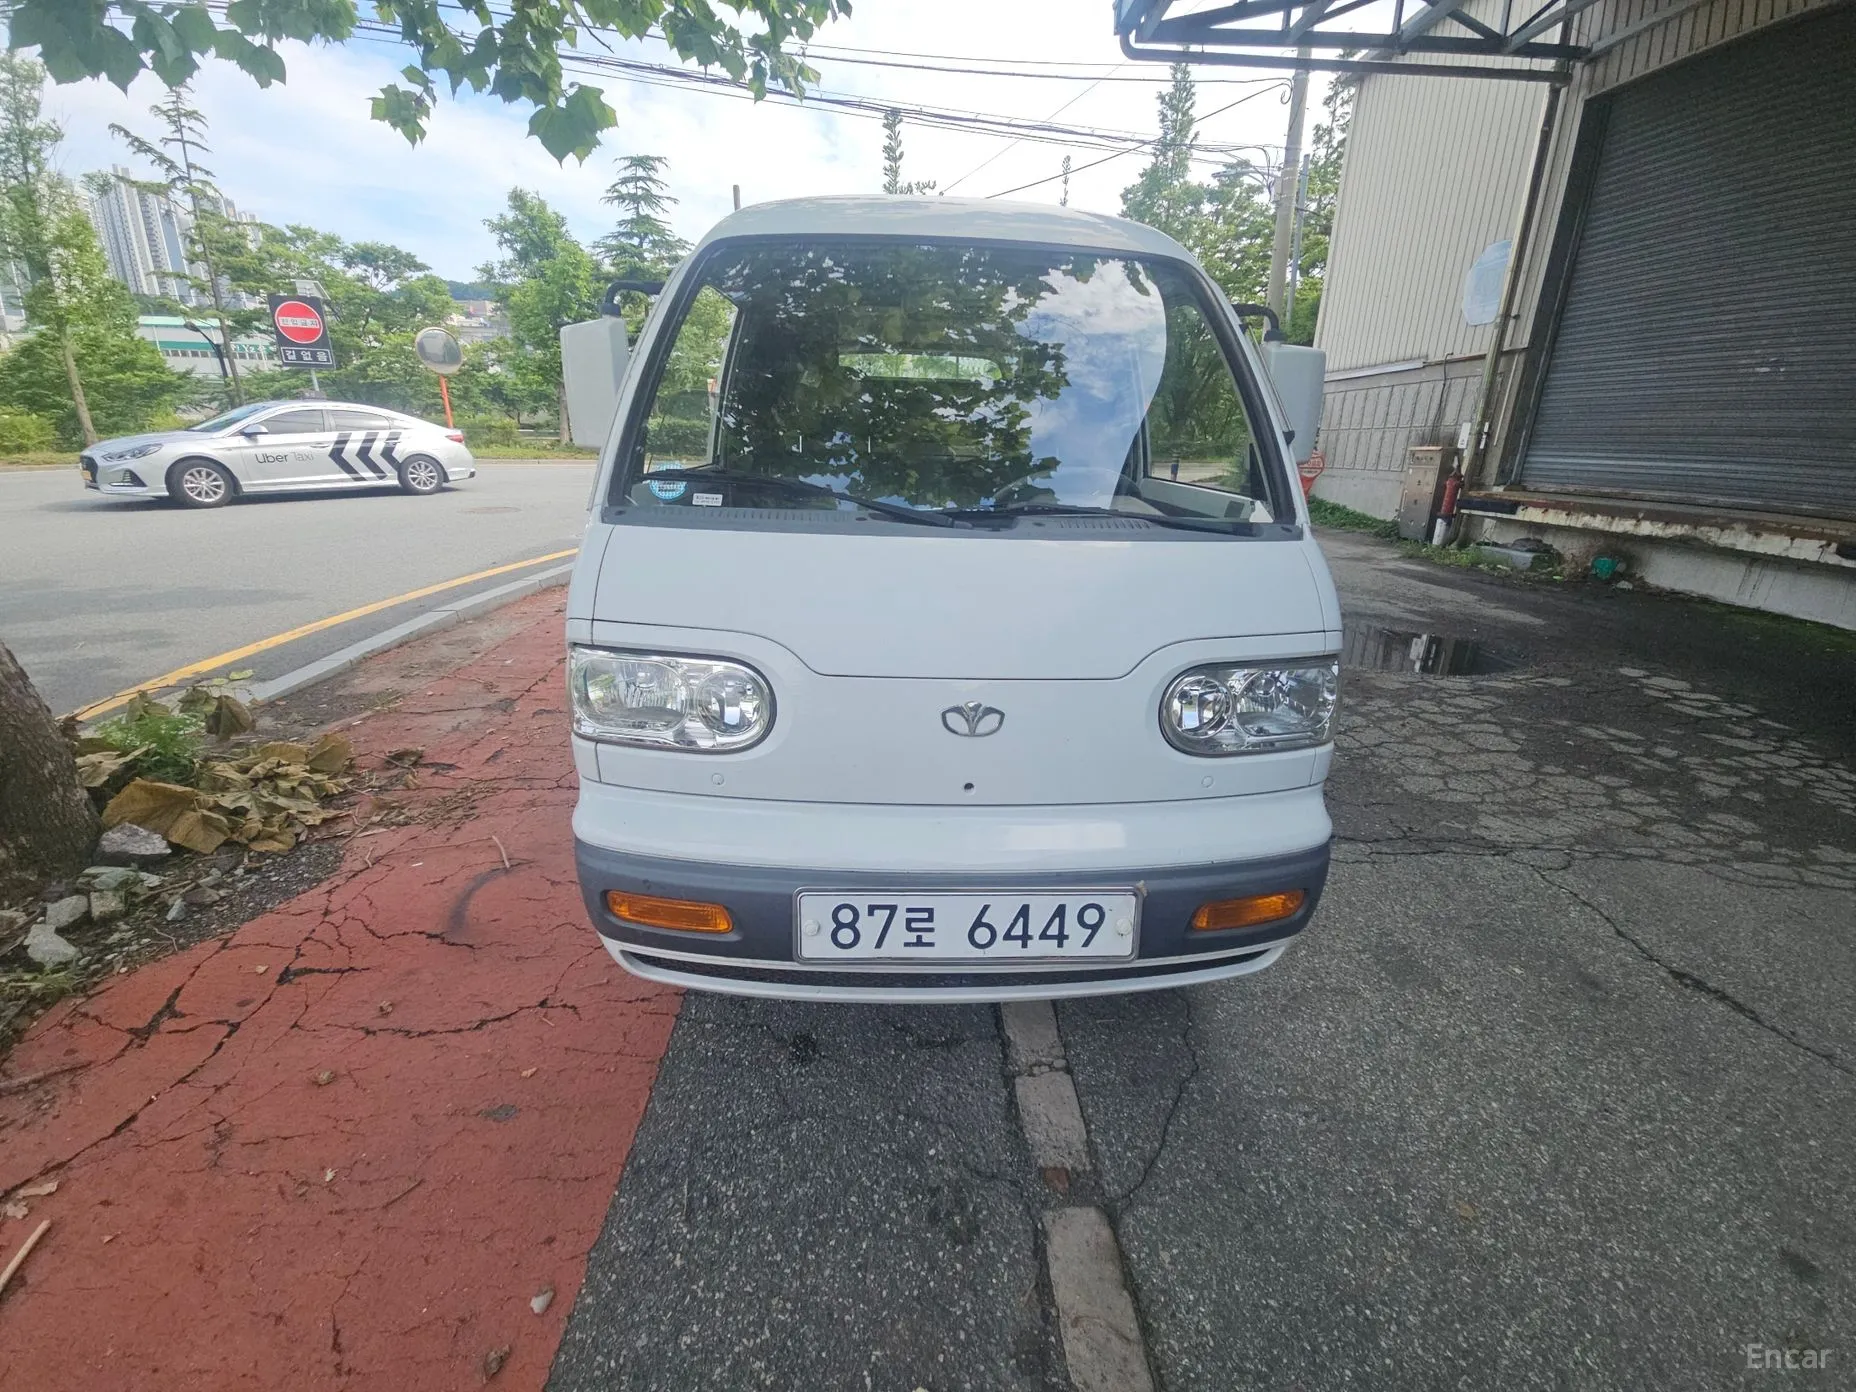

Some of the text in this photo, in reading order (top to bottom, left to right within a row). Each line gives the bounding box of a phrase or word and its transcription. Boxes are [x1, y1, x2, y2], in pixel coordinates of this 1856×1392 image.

[255, 451, 314, 464] Uber Taxi
[830, 903, 1107, 950] 87로 6449
